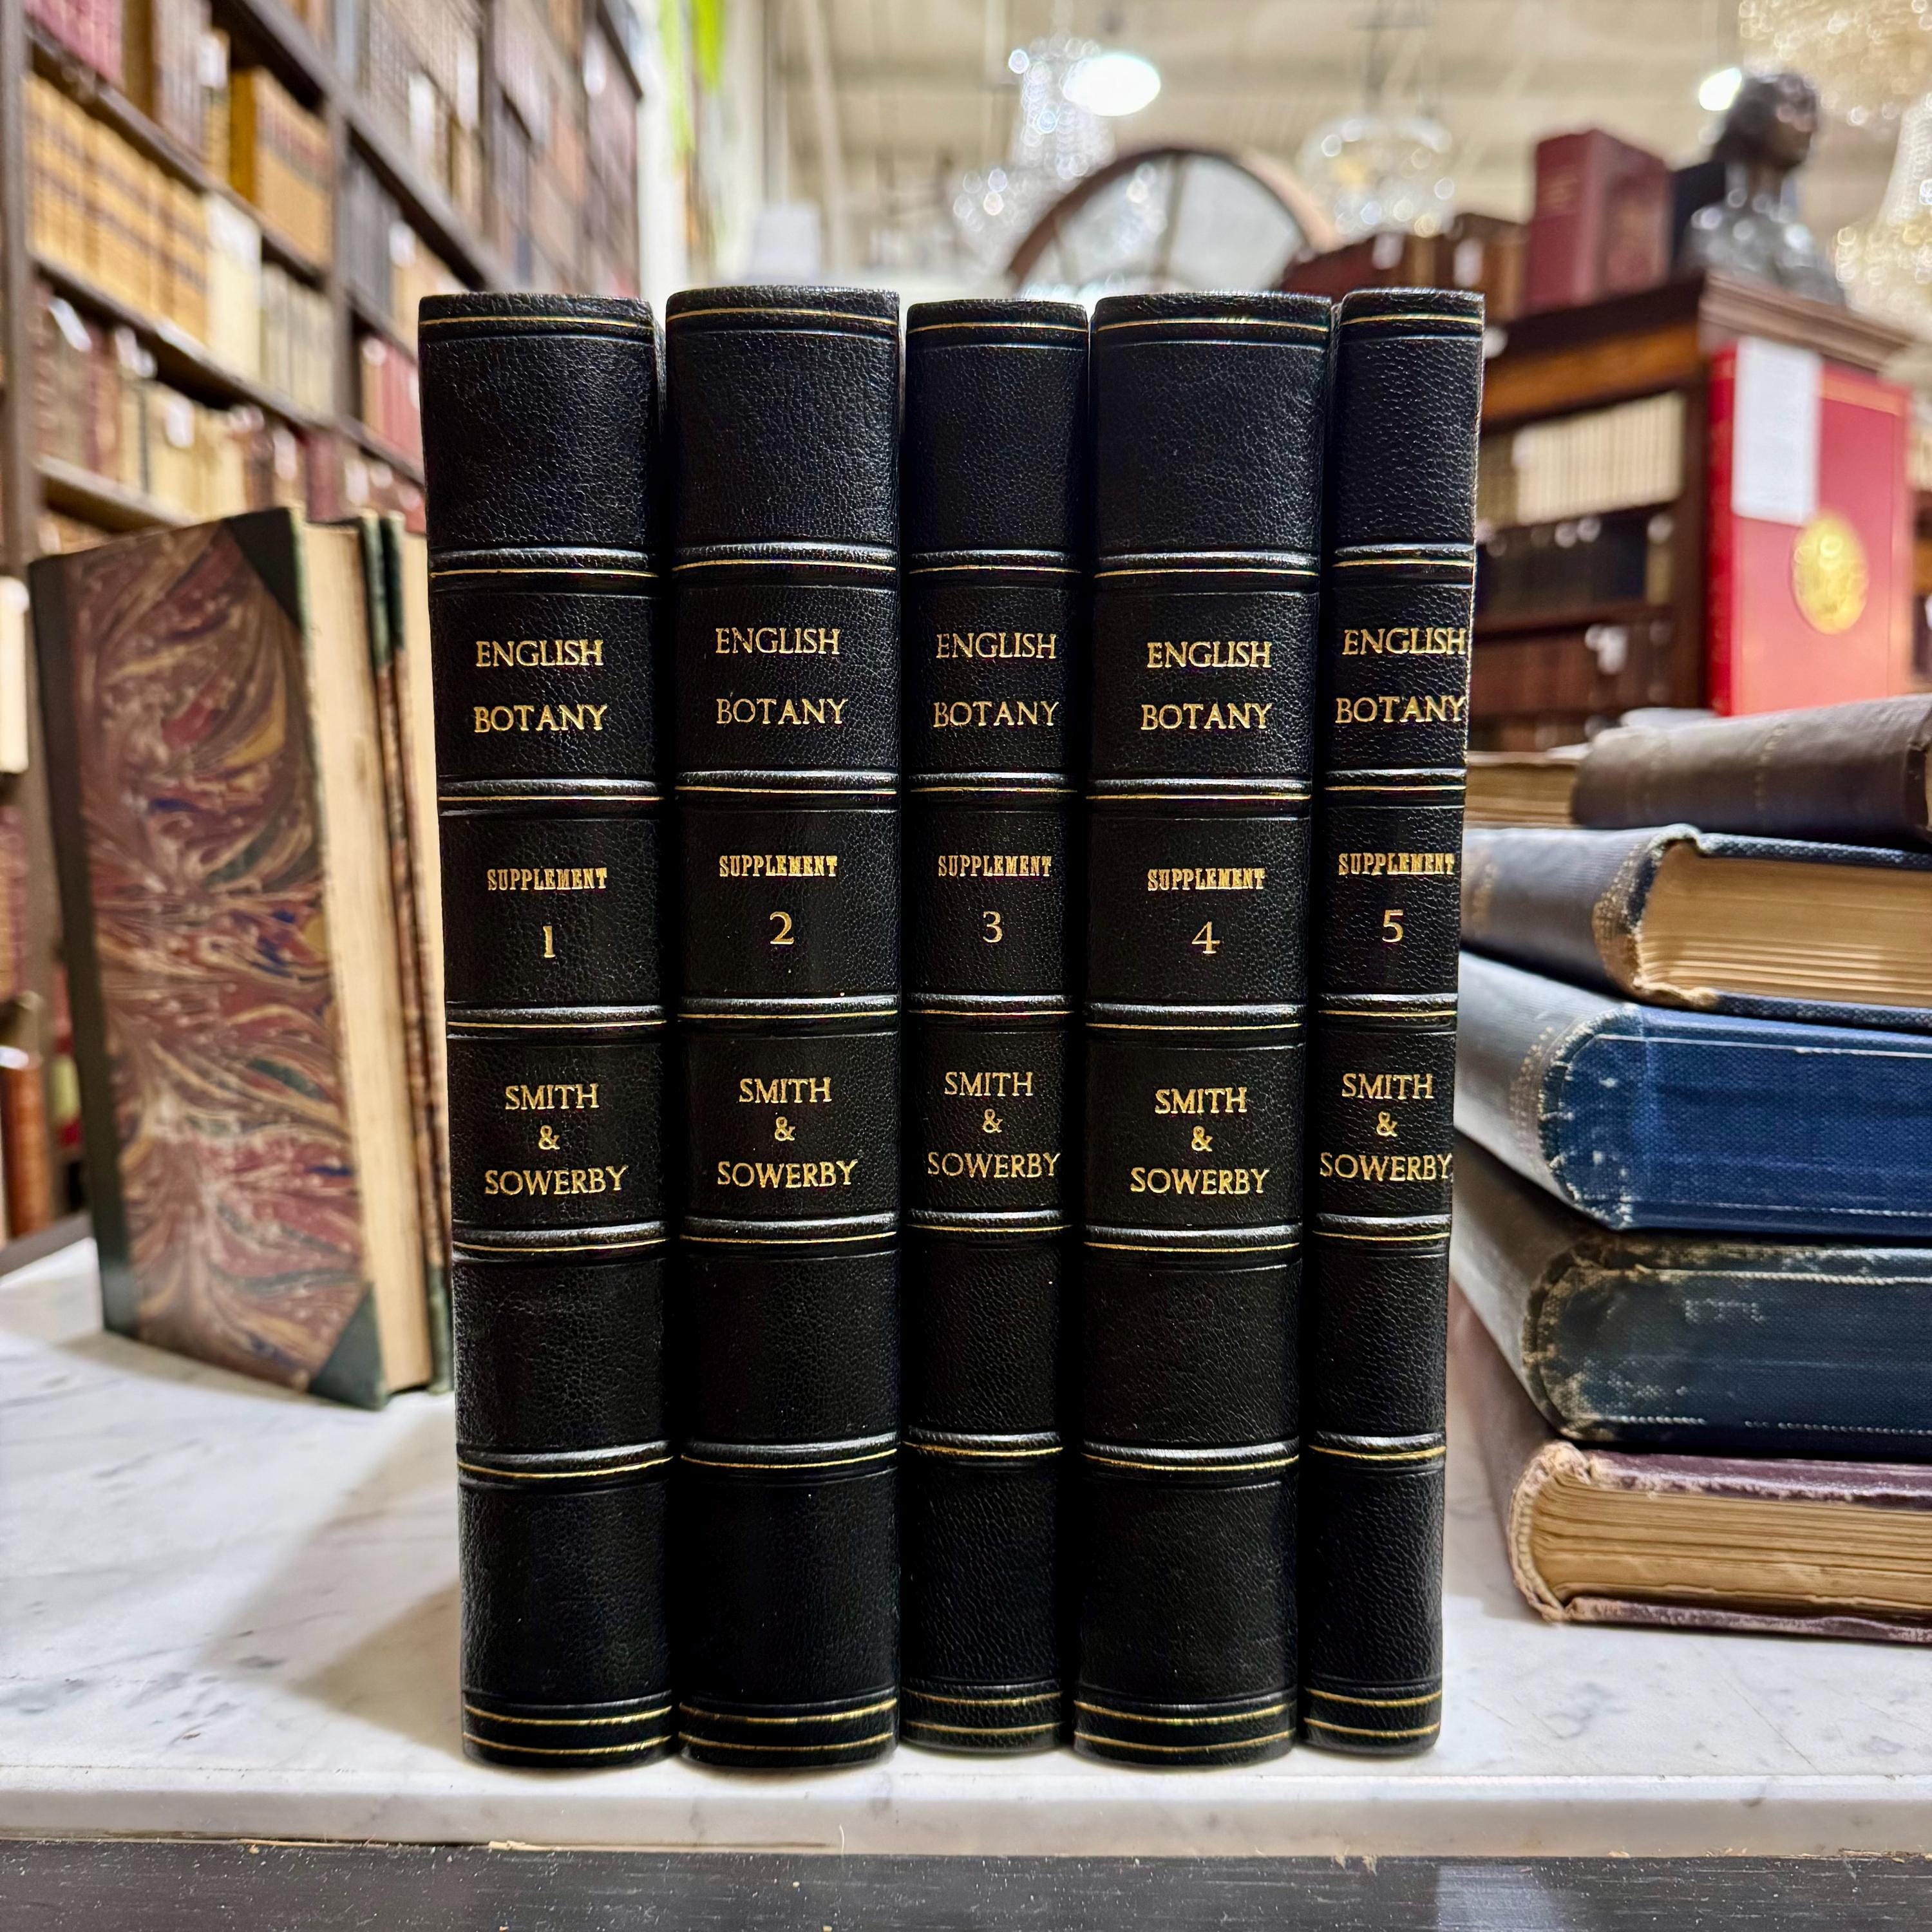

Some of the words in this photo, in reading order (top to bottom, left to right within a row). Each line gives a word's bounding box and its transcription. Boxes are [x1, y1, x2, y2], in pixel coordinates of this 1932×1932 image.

[476, 639, 603, 667] ENGLISH
[715, 628, 840, 654] ENGLISH
[937, 632, 1056, 659] ENGLISH
[1147, 641, 1271, 668] ENGLISH
[1343, 628, 1466, 655] ENGLISH
[474, 704, 607, 733] BOTANY
[716, 699, 846, 724] BOTANY
[933, 701, 1057, 727] BOTANY
[1141, 703, 1271, 730] BOTANY
[1335, 696, 1464, 724] BOTANY
[719, 855, 837, 877] SUPPLEMENT
[938, 855, 1051, 876] SUPPLEMENT
[1339, 853, 1454, 875] SUPPLEMENT
[488, 867, 607, 891] SUPPLEMENT
[1148, 868, 1265, 891] SUPPLEMENT
[770, 912, 794, 944] 2
[983, 911, 1003, 943] 3
[1191, 922, 1220, 954] 4
[1383, 909, 1403, 942] 5
[543, 926, 554, 958] 1
[506, 1083, 598, 1110] SMITH
[739, 1077, 832, 1103] SMITH
[944, 1072, 1033, 1097] SMITH
[1342, 1074, 1432, 1100] SMITH
[1155, 1087, 1247, 1114] SMITH
[775, 1117, 795, 1141] &
[981, 1110, 1003, 1133] &
[1376, 1112, 1397, 1137] &
[538, 1125, 560, 1150] &
[1191, 1126, 1213, 1151] &
[717, 1160, 855, 1188] SOWERBY
[928, 1152, 1059, 1178] SOWERBY
[1320, 1152, 1452, 1182] SOWERBY
[485, 1165, 627, 1195] SOWERBY
[1130, 1168, 1267, 1195] SOWERBY
